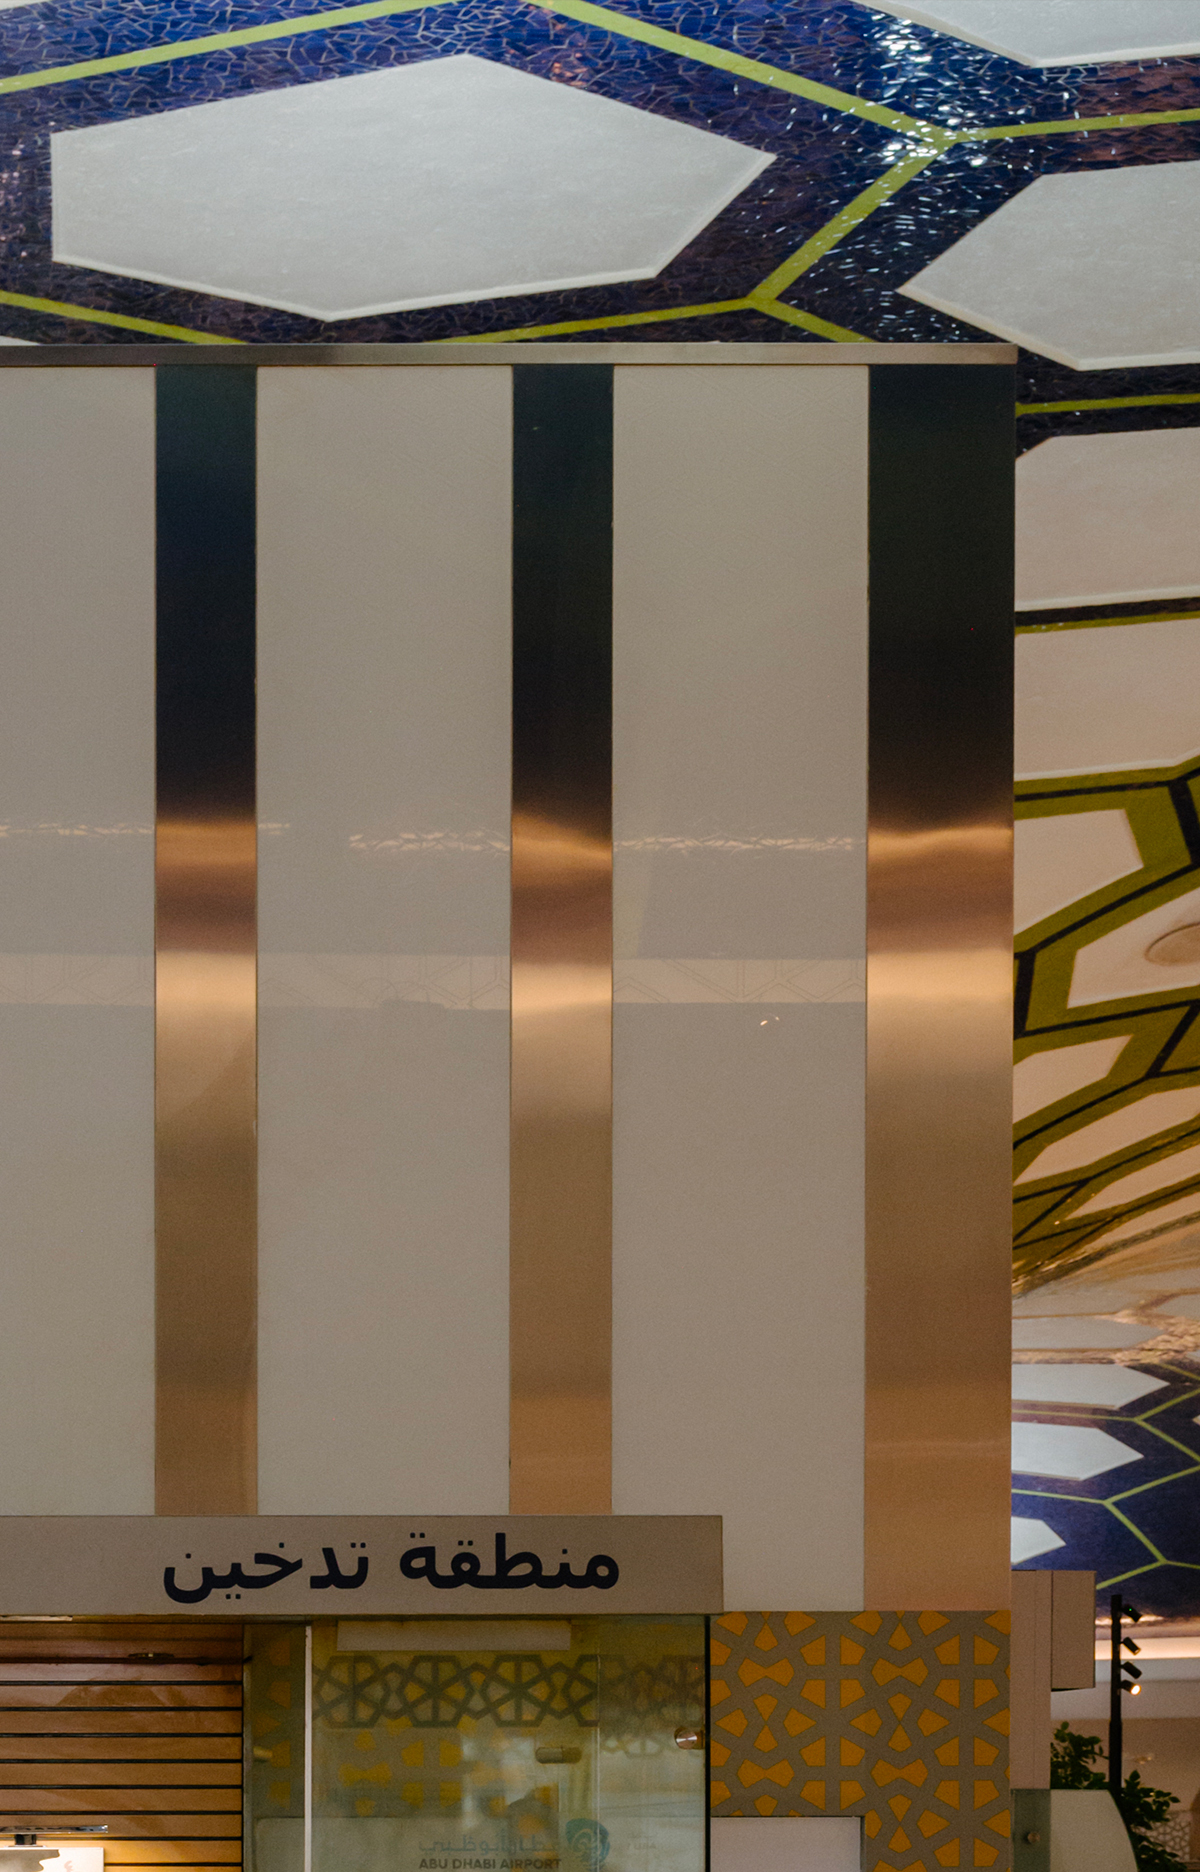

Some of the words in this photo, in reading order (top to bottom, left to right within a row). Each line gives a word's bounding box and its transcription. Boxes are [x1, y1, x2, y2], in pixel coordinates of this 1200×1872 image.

[164, 1541, 369, 1604] تدخين
[400, 1532, 619, 1590] منطقة
[418, 1858, 448, 1870] ABU
[452, 1858, 496, 1870] DHABI
[499, 1858, 562, 1870] AIRPORT
